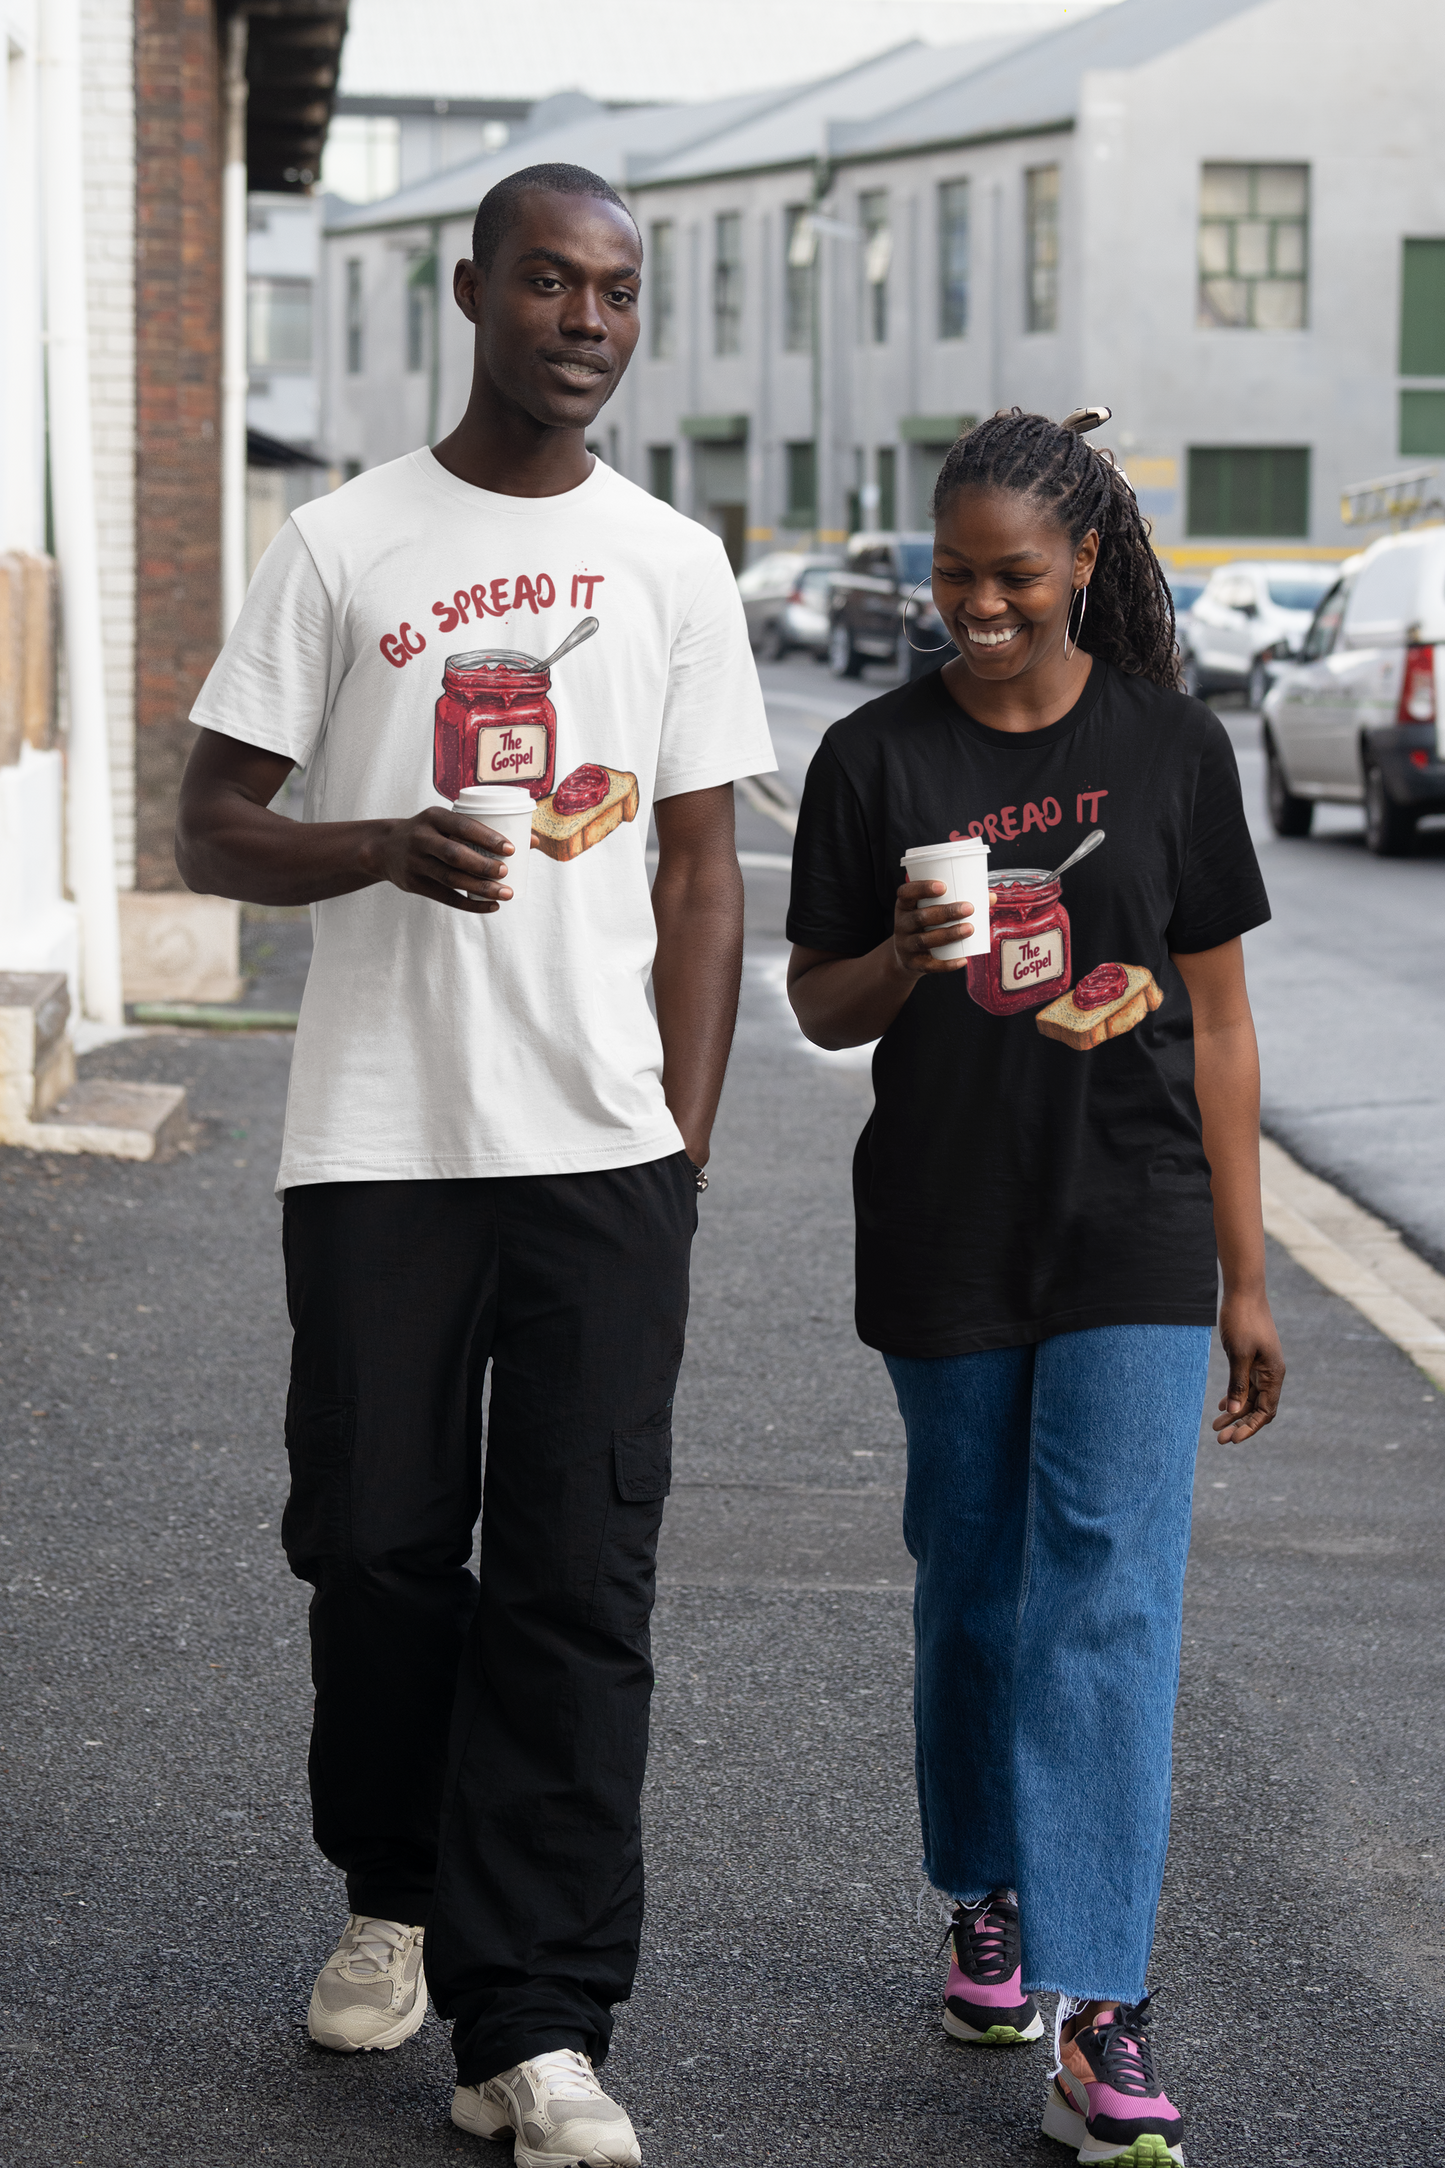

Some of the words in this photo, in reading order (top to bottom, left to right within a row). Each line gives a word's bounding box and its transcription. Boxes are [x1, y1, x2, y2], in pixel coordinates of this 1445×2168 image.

[380, 622, 426, 668] GO
[432, 573, 556, 633] SPREAD
[571, 574, 605, 609] IT
[499, 729, 522, 751] The
[491, 746, 533, 774] Gospel
[1076, 790, 1108, 823] IT
[1013, 950, 1052, 981] Gospel
[1018, 940, 1040, 962] The
